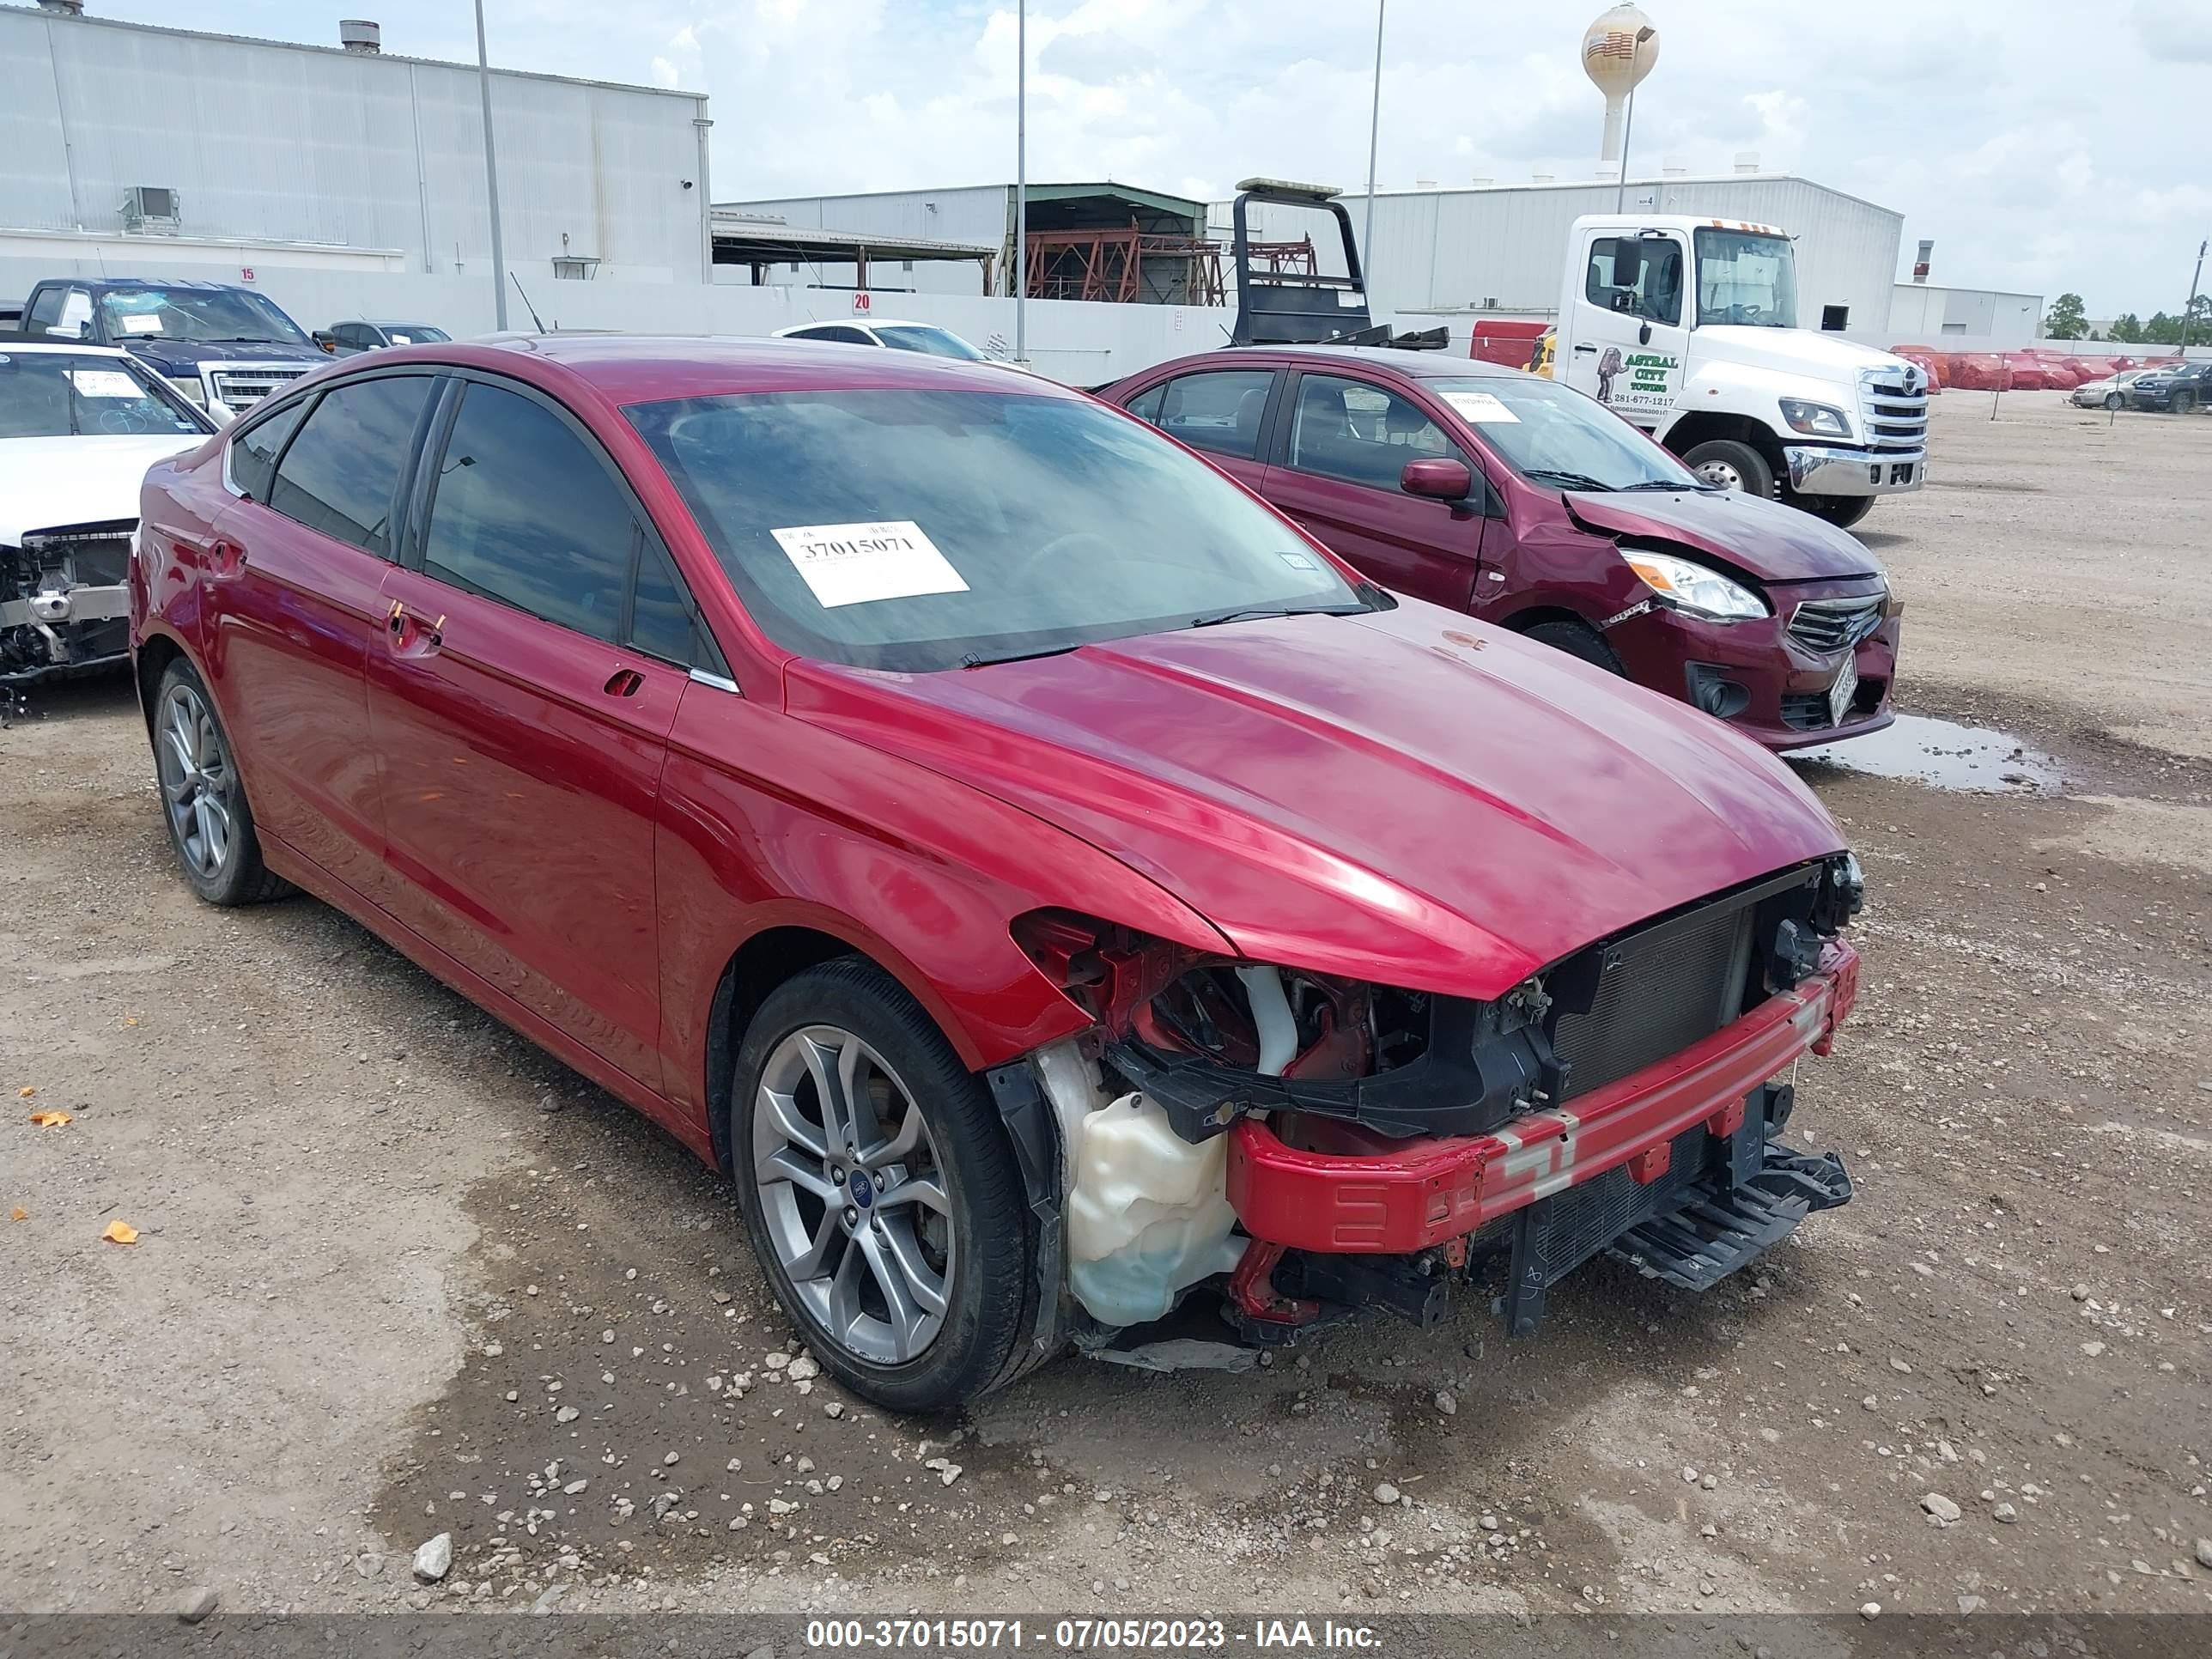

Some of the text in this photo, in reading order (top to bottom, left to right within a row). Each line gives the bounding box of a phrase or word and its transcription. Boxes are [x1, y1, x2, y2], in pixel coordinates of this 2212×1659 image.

[241, 268, 254, 280] 15
[854, 294, 870, 309] 20
[1625, 354, 1678, 368] ASTRAL
[1635, 368, 1667, 381] CITY
[1631, 382, 1667, 393] TOWING
[1614, 394, 1674, 406] 281-677-1217
[799, 538, 915, 558] 37015071
